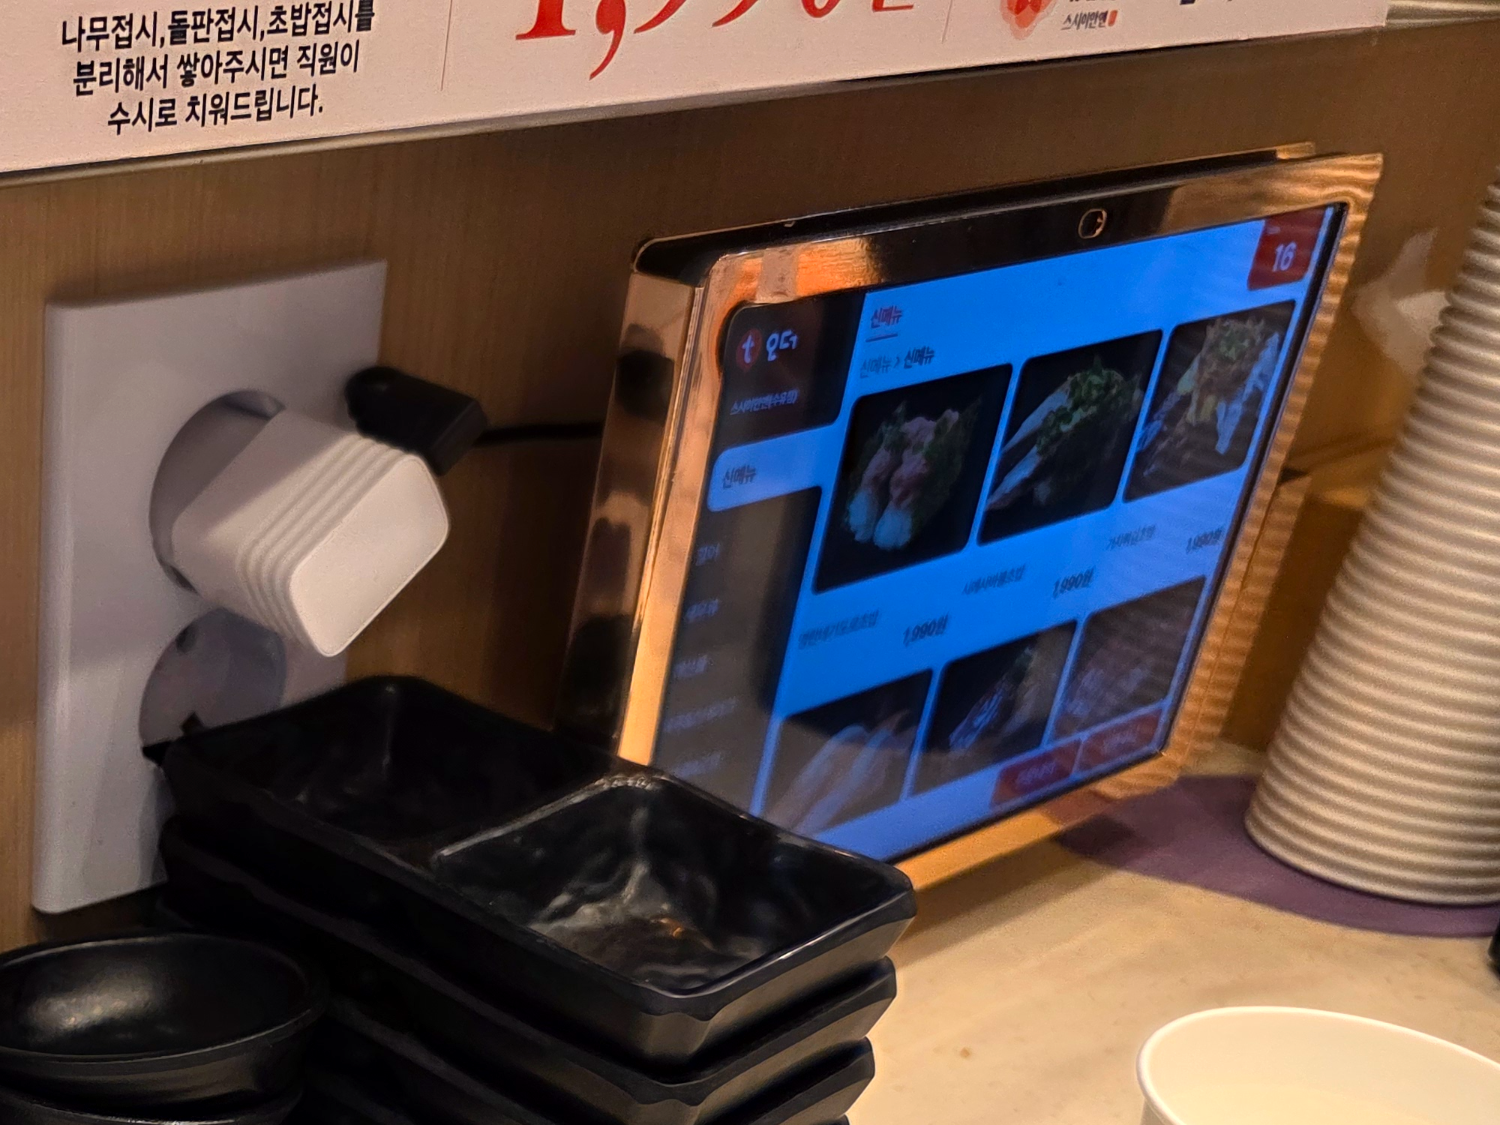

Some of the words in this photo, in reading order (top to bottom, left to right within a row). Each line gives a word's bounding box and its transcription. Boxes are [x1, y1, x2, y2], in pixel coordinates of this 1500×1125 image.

[61, 0, 376, 53] 나무접시,돌판접시,초밥접시를
[72, 54, 168, 97] 분리해서
[176, 47, 289, 88] 쌓아주시면
[296, 40, 360, 77] 직원이
[107, 98, 178, 136] 수시로
[185, 83, 324, 127] 치워드립니다.
[1272, 242, 1297, 272] 16
[871, 305, 902, 329] 신메뉴
[904, 345, 935, 370] 신메뉴
